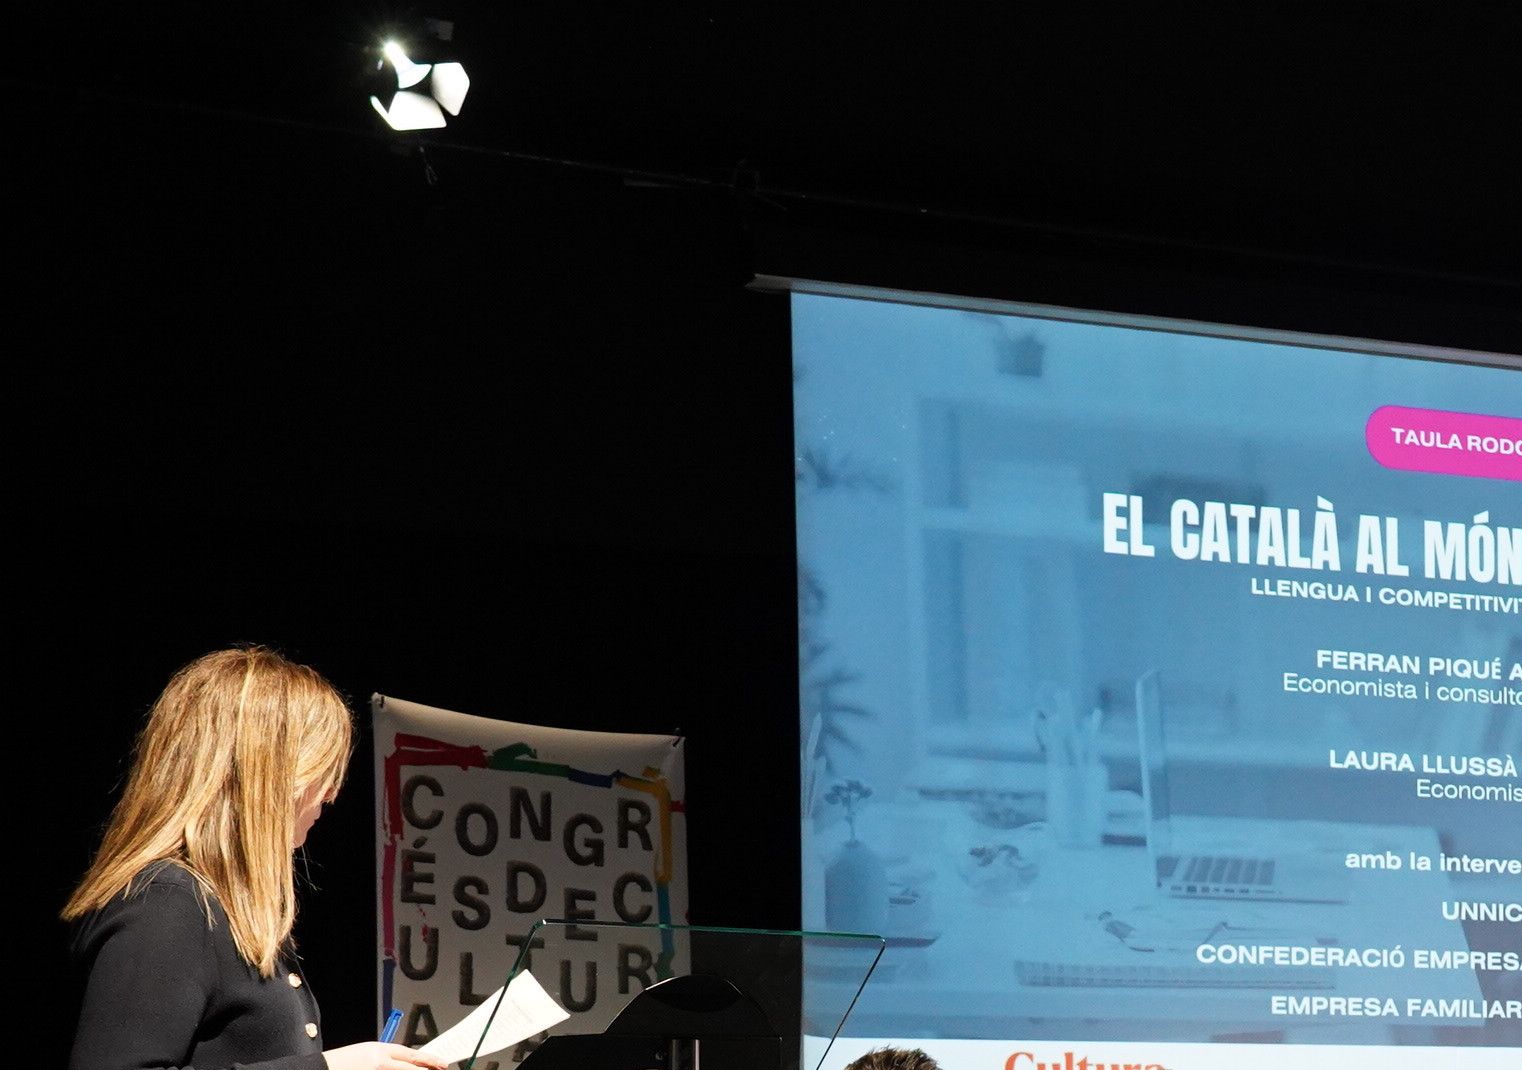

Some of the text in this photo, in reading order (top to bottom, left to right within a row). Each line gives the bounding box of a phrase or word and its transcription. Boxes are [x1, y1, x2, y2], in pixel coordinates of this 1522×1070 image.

[1391, 427, 1463, 450] TAULA
[1103, 492, 1155, 557] EL
[1170, 495, 1341, 571] CATALÀ
[1355, 514, 1409, 577] AL
[1251, 578, 1360, 602] LLENGUA
[1366, 586, 1371, 603] I
[1317, 649, 1420, 675] FERRAN
[1429, 656, 1501, 681] PIQUÉ
[1283, 672, 1417, 700] Economista
[1424, 682, 1430, 700] i
[1329, 749, 1415, 773] LAURA
[1422, 753, 1518, 778] LLUSSÀ
[1345, 851, 1402, 871] amb
[1410, 852, 1431, 871] la
[1196, 944, 1405, 969] CONFEDERACIÓ
[1271, 996, 1399, 1018] EMPRESA
[1407, 999, 1522, 1019] FAMILIAR
